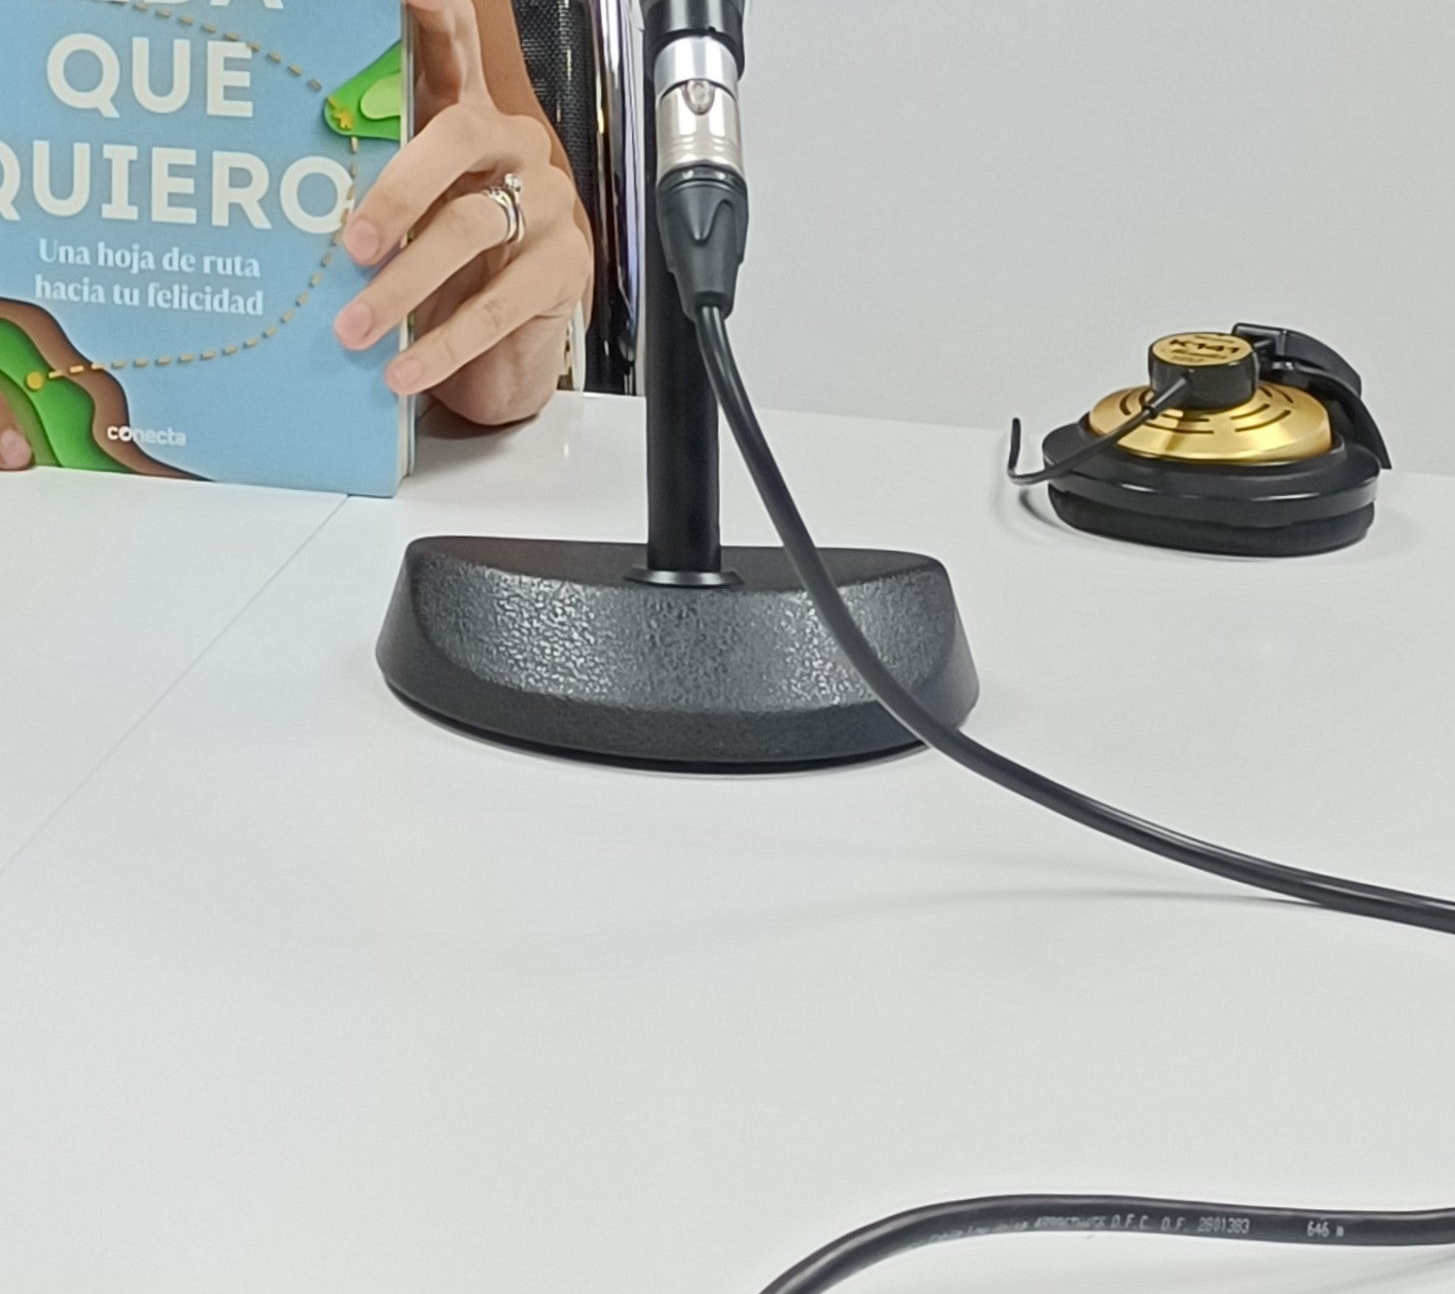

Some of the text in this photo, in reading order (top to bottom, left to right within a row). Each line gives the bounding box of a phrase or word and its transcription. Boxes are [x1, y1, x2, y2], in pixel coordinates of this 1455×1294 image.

[46, 33, 254, 119] QUE
[39, 237, 261, 278] Una hoja de ruta
[34, 273, 264, 316] hacia tu felicidad
[106, 425, 187, 447] conecta
